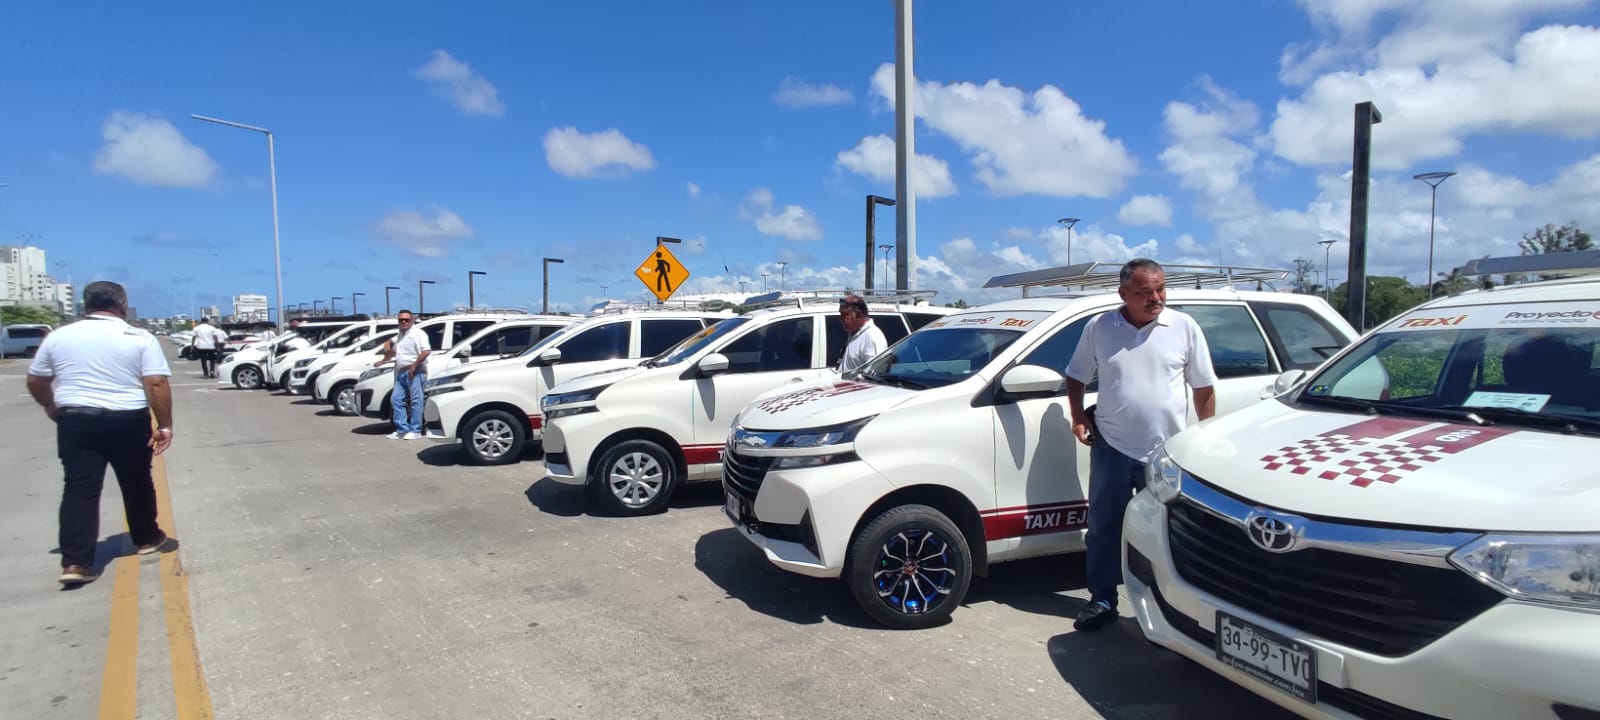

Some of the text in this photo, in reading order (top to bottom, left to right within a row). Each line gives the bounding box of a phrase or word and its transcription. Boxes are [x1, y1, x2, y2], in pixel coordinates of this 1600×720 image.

[1504, 310, 1592, 320] Proyecto
[1000, 318, 1035, 327] Taxi
[1398, 315, 1468, 328] Taxi
[1023, 509, 1089, 530] TAXI EJ
